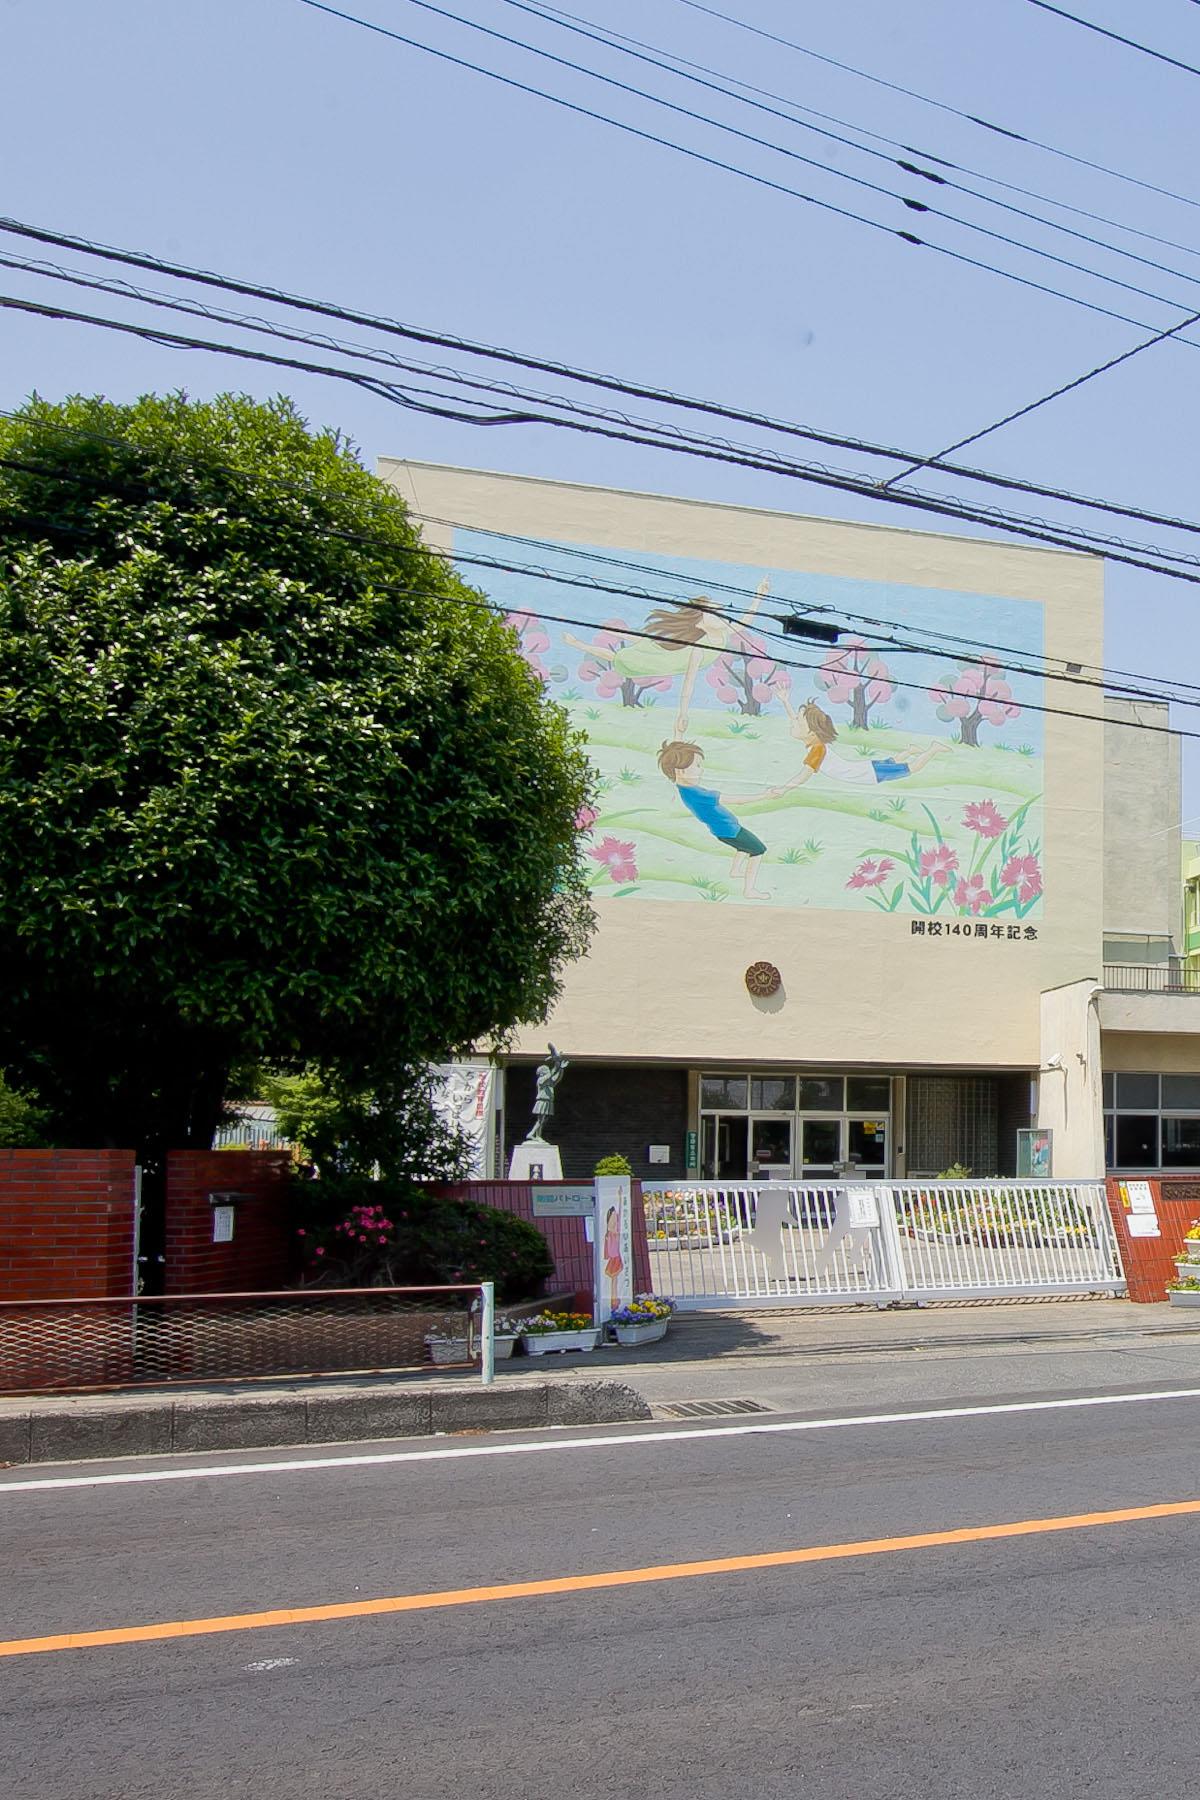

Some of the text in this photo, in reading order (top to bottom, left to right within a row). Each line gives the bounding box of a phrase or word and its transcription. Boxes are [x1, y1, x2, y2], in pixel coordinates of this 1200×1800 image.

[911, 920, 1039, 941] 開校140周年記念
[536, 1193, 593, 1203] パトロー
